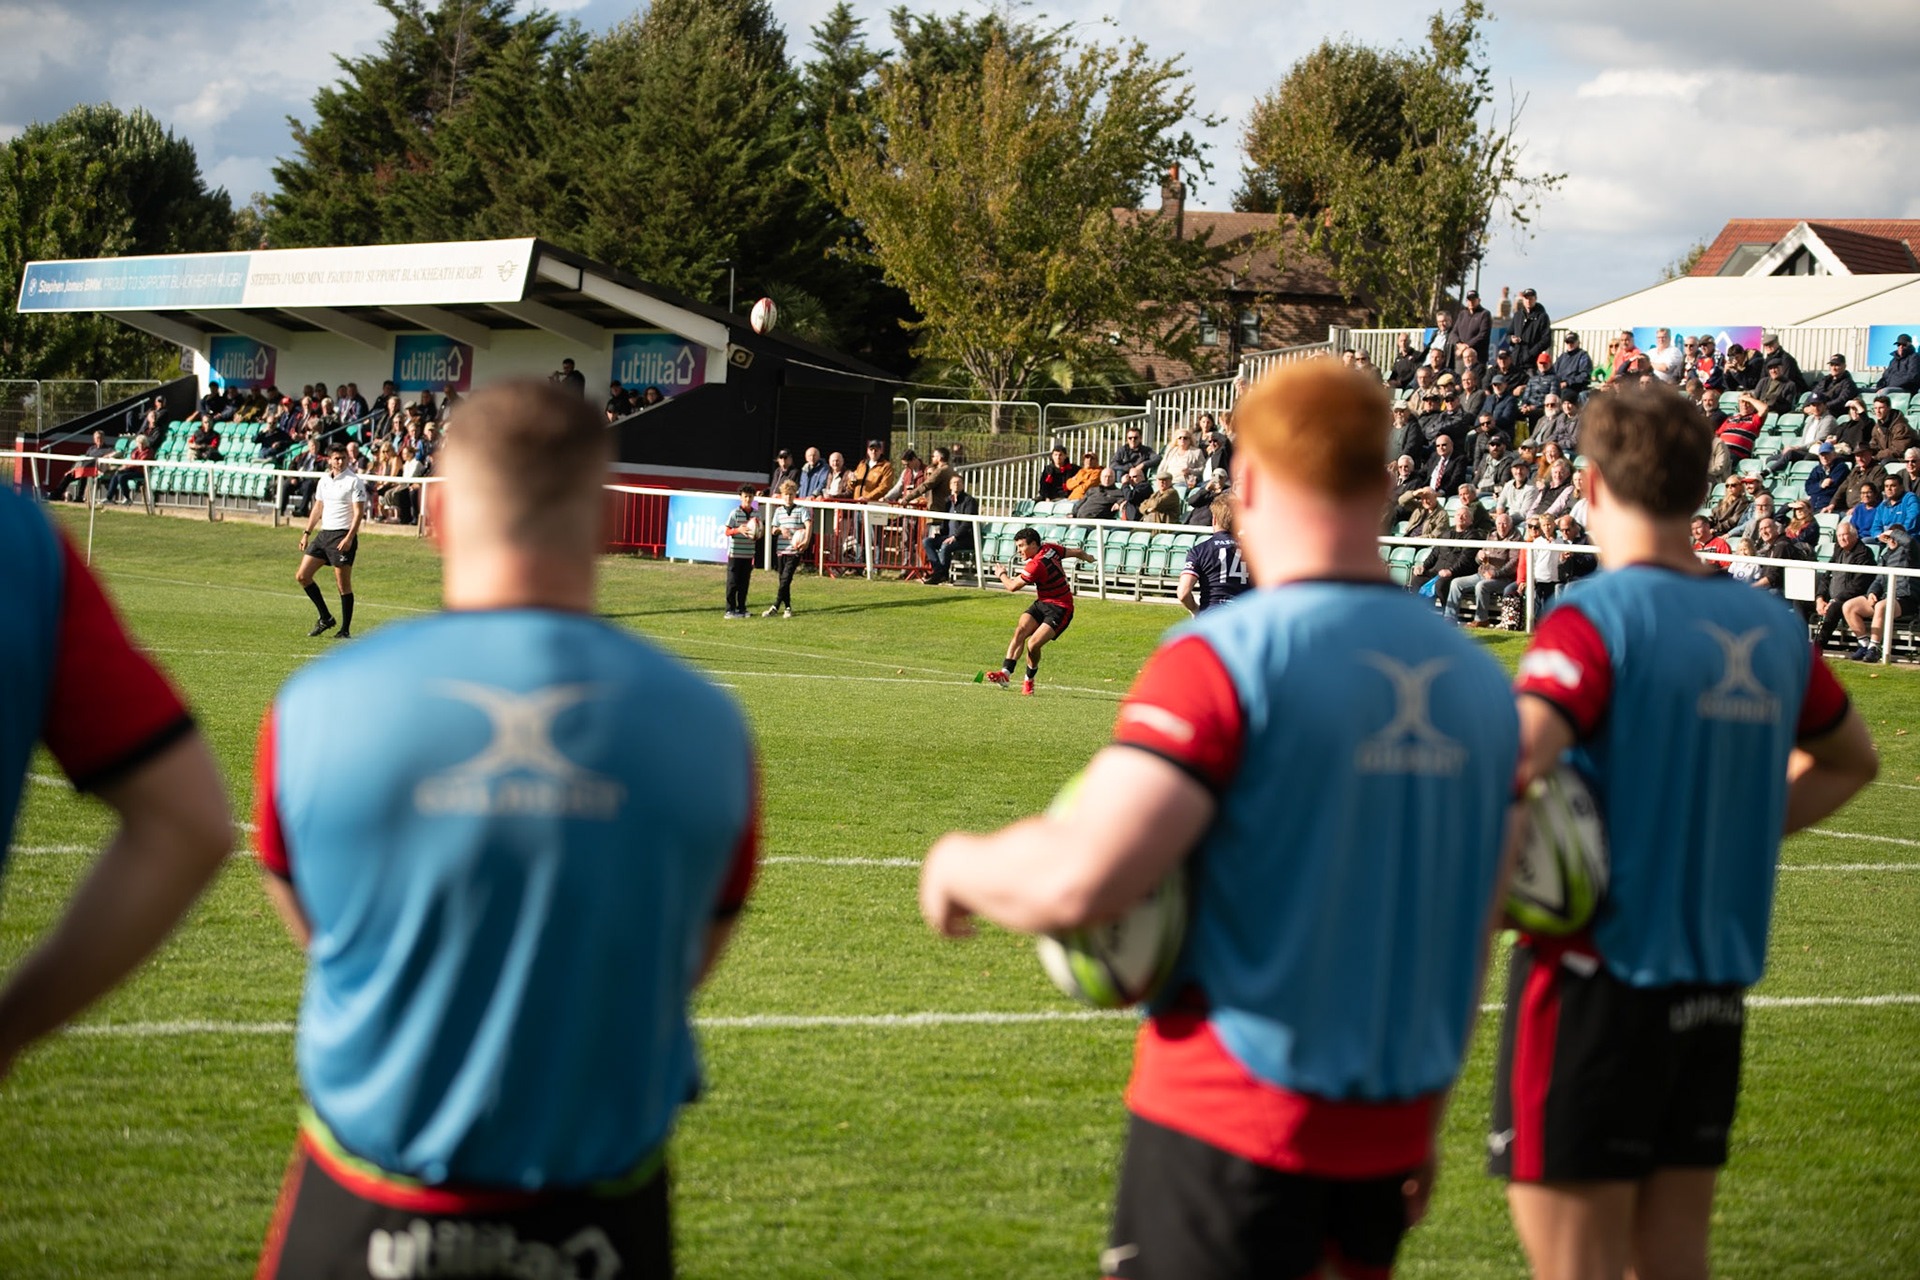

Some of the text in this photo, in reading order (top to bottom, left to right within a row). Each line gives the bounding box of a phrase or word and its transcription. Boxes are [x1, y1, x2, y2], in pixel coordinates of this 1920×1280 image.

[38, 279, 64, 296] Stephen
[63, 279, 84, 293] James
[127, 276, 138, 290] TO
[138, 274, 171, 290] SUPPORT
[353, 270, 364, 283] TO
[365, 268, 401, 283] SUPPORT
[401, 266, 454, 282] BLACKHEATH
[215, 352, 255, 379] utilita
[401, 351, 447, 381] utilita
[621, 352, 675, 384] utilita
[675, 514, 728, 549] utilita
[1218, 547, 1249, 584] 14
